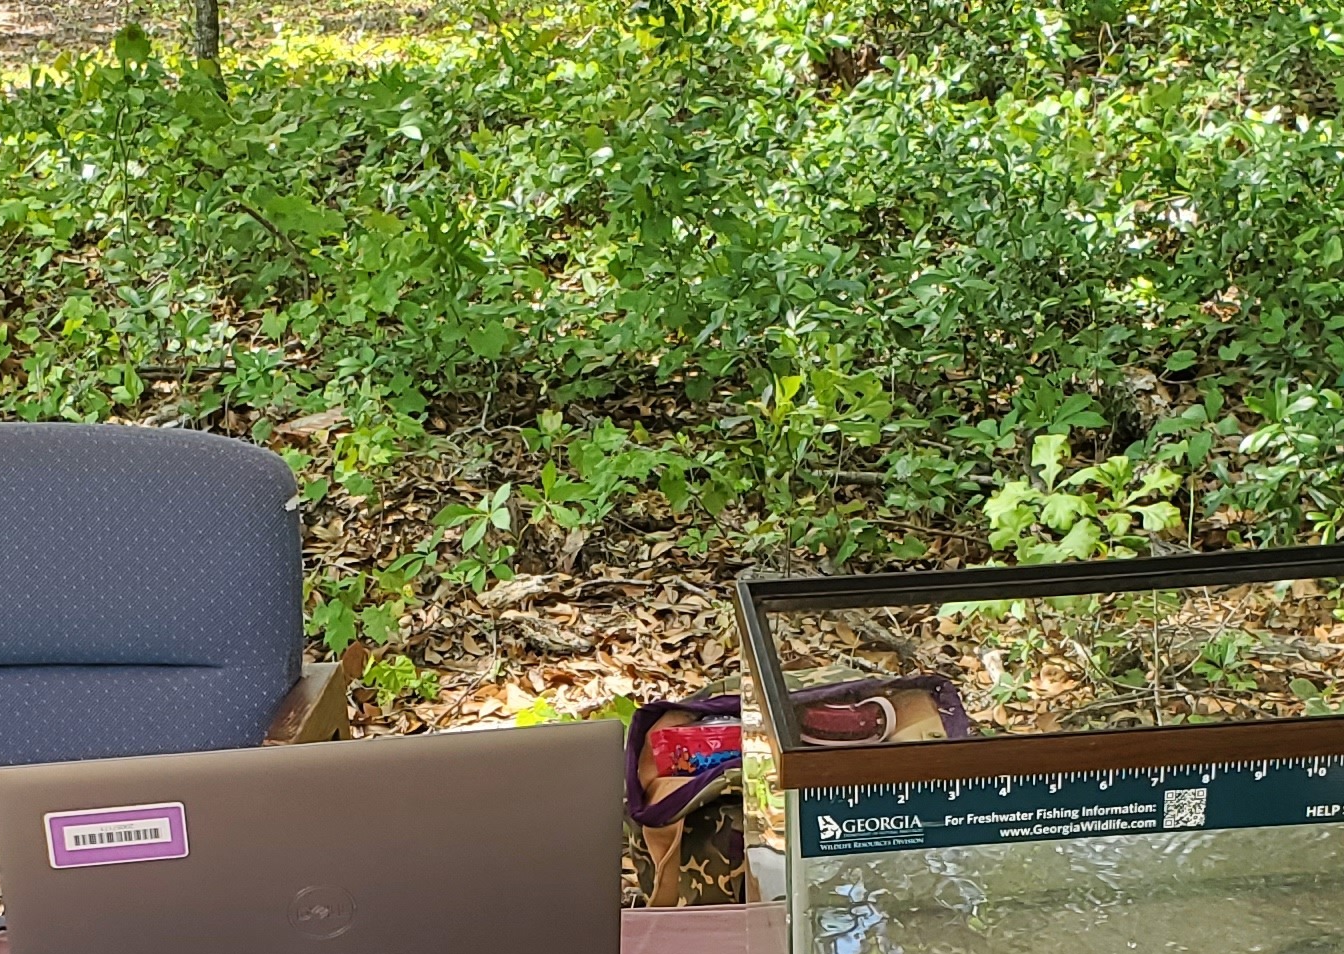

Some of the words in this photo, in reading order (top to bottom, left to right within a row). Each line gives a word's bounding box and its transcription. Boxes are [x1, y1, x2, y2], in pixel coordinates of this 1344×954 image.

[847, 798, 854, 808] 1
[897, 794, 905, 804] 2
[948, 791, 956, 800] 3
[998, 787, 1007, 797] 4
[1048, 784, 1056, 793] 5
[1099, 781, 1107, 791] 6
[1150, 777, 1158, 787] 7
[1202, 774, 1210, 784] 8
[1254, 771, 1263, 781] 9
[945, 815, 964, 827] For
[967, 811, 1034, 825] Freshwater
[1036, 808, 1080, 821] Fishing
[1081, 803, 1157, 817] Information:
[1306, 804, 1341, 818] HELP
[842, 815, 923, 834] GEORGIA
[999, 818, 1156, 838] www.GeorgiaWildlife.com
